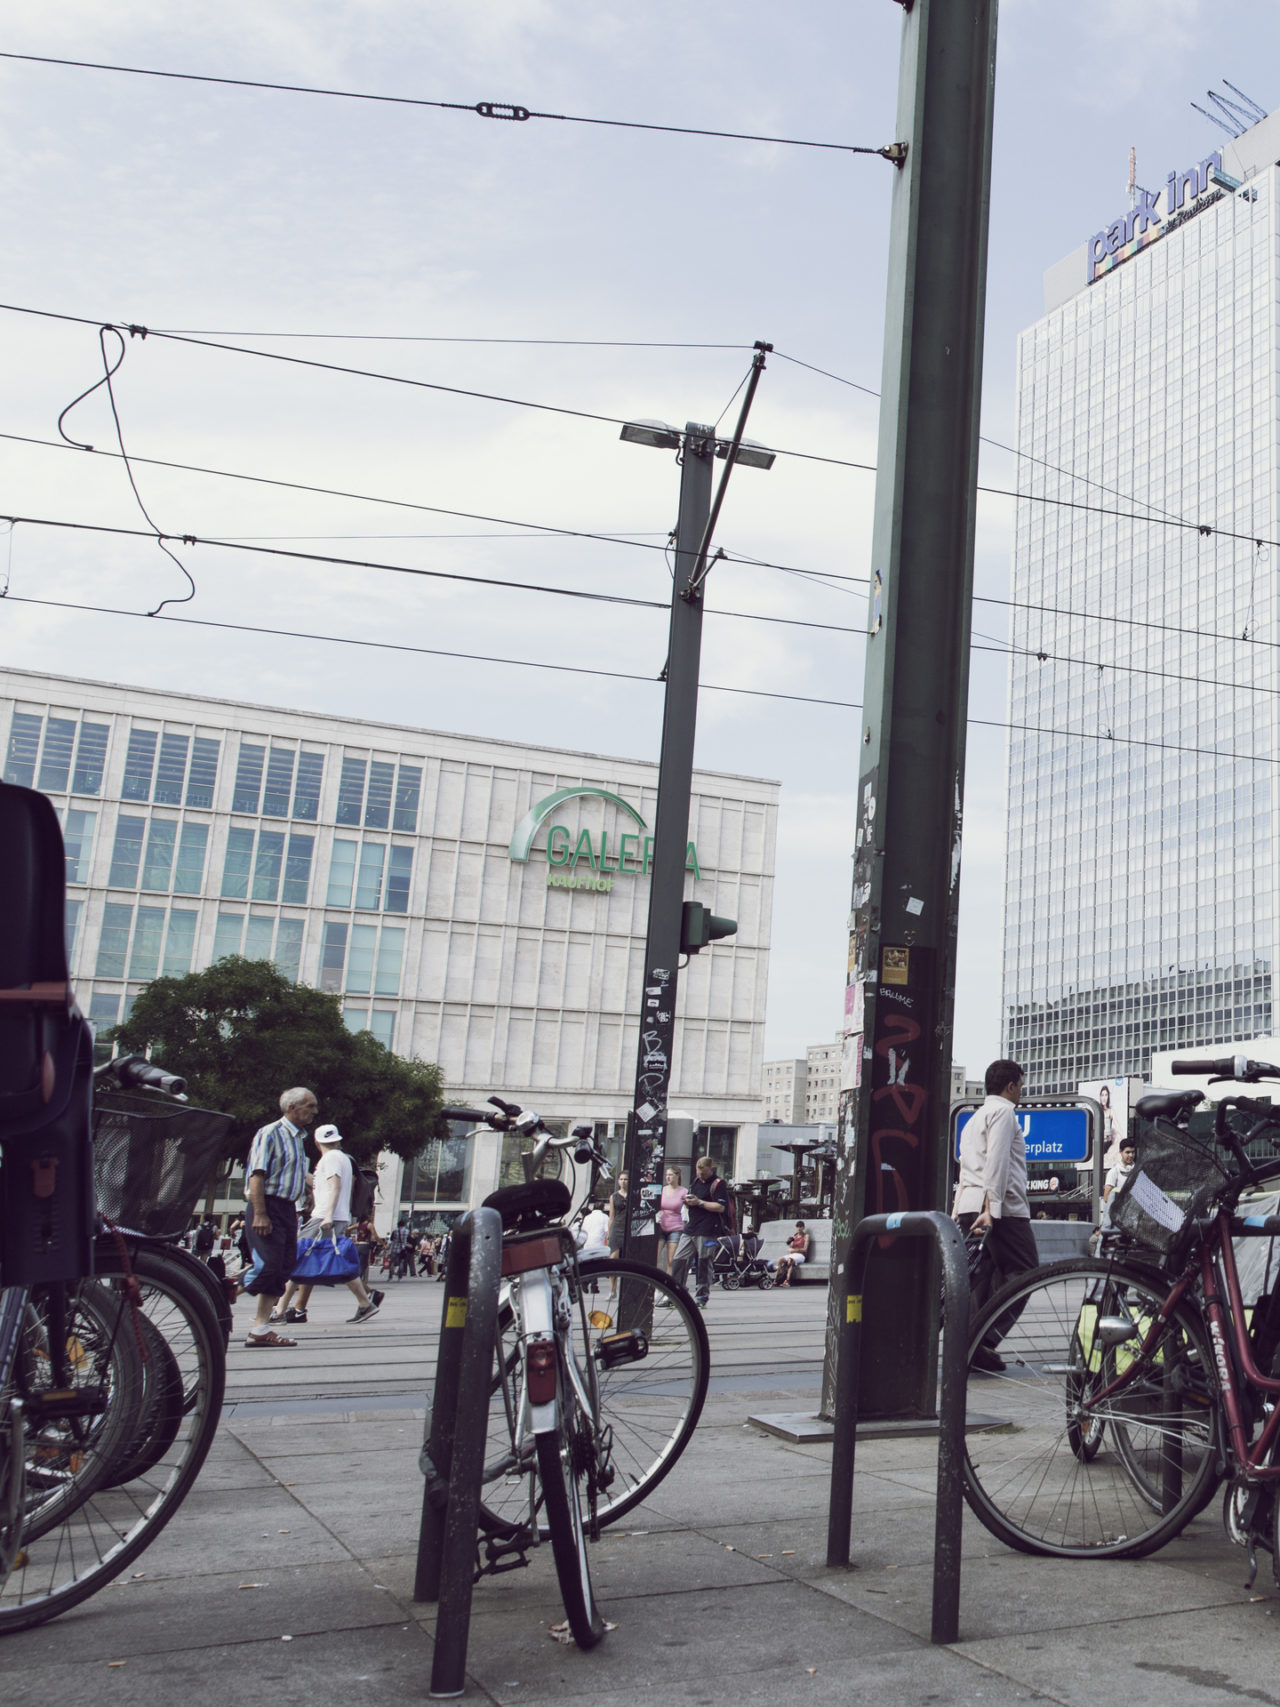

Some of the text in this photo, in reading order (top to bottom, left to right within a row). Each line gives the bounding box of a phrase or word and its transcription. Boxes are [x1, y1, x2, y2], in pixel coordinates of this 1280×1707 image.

[1088, 150, 1222, 285] park inn
[546, 825, 701, 881] GALERA
[1024, 1141, 1063, 1156] erplatz
[1030, 1179, 1049, 1190] KING
